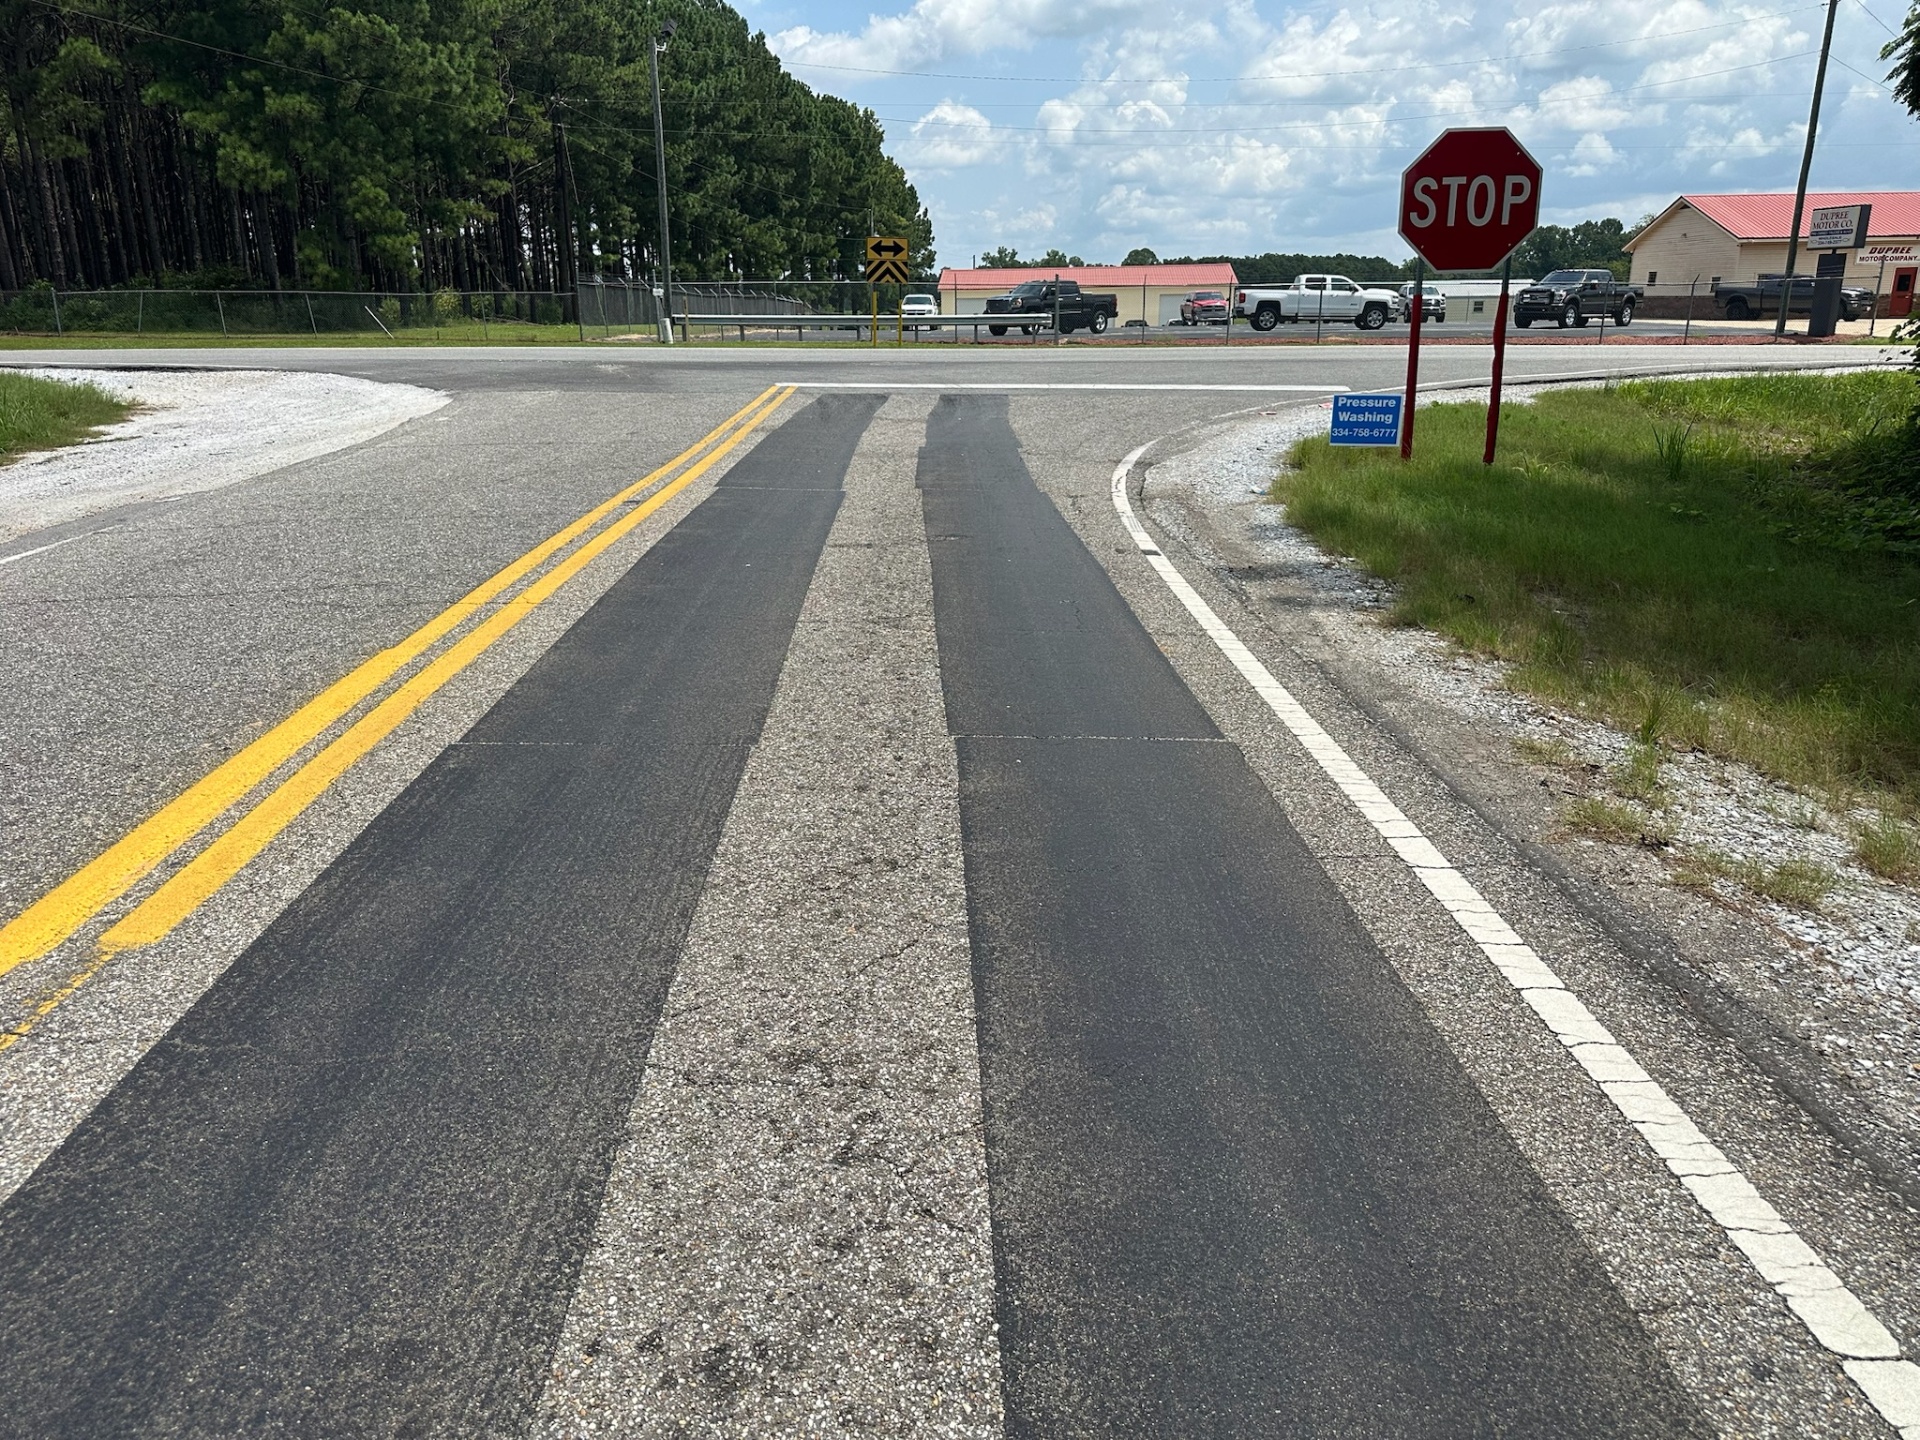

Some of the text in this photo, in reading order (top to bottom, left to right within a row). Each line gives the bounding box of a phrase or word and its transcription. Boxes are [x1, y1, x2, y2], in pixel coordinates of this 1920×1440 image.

[1409, 175, 1532, 228] STOP
[1820, 211, 1850, 221] DUPREE
[1812, 219, 1854, 230] MOTOR CO.
[1869, 246, 1914, 254] DUPREE
[1338, 397, 1396, 407] Pressure
[1338, 411, 1393, 425] Washing
[1332, 428, 1397, 437] 334-758-6777
